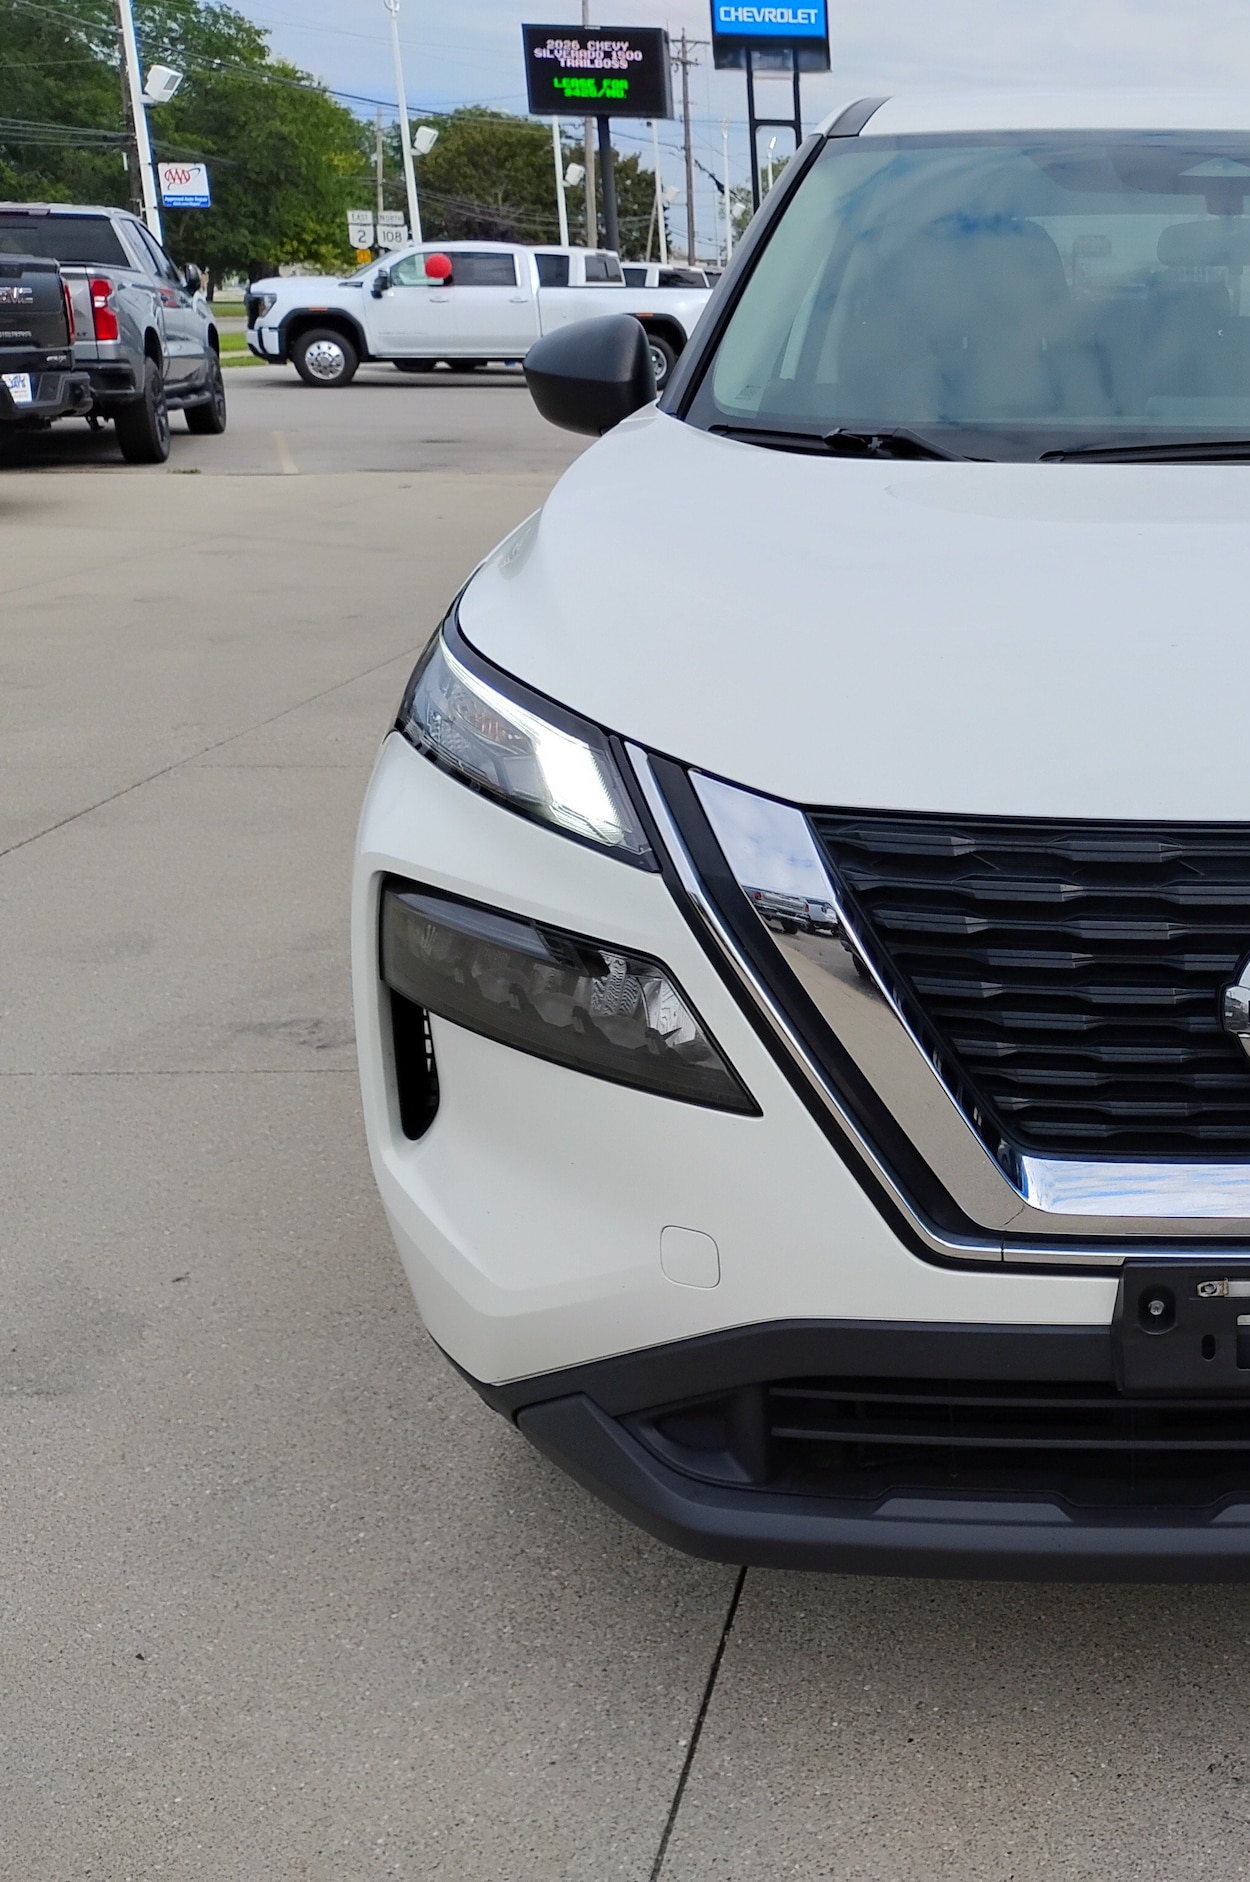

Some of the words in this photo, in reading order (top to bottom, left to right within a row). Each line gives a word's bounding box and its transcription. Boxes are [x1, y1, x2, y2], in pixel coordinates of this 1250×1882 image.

[719, 6, 818, 24] CHEVROLET
[546, 39, 580, 50] 2026
[587, 40, 629, 52] CHEVY
[534, 47, 604, 60] SILVERADO
[611, 50, 643, 61] 1500
[558, 58, 628, 69] TRAILBOSS
[553, 76, 595, 88] LEASE
[602, 78, 628, 90] FOR
[166, 168, 189, 184] AAA
[352, 213, 368, 222] EAST
[379, 214, 402, 222] NORTH
[358, 230, 367, 243] 2
[383, 230, 402, 243] 108
